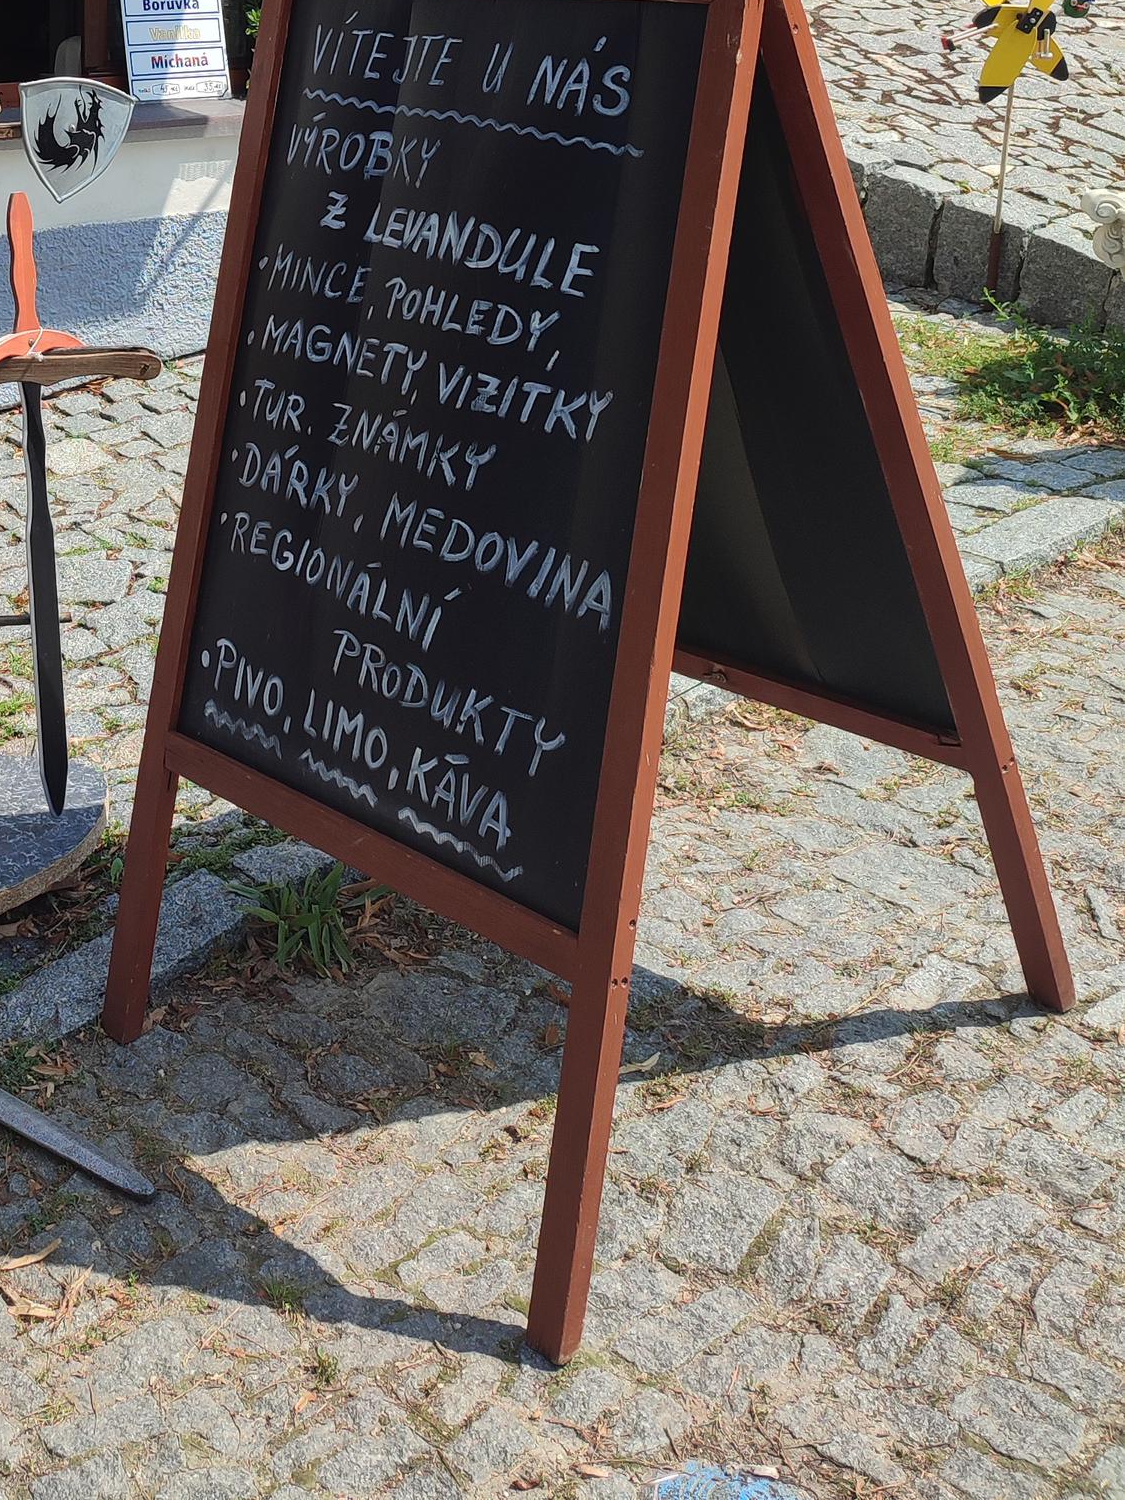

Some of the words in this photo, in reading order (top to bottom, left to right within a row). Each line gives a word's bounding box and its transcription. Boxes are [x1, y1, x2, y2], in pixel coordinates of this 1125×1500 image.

[149, 25, 201, 41] Vanilka
[312, 11, 463, 86] VÍTEJTE
[482, 42, 514, 93] U
[527, 35, 631, 116] NÁS
[286, 112, 442, 188] VÝROBKY
[363, 202, 600, 298] LEVANDULE
[252, 379, 313, 435] TUR.
[326, 403, 497, 491] ZNÁMKY
[438, 362, 614, 443] VIZITKY
[230, 511, 463, 652] REGIONÁLNÍ
[380, 492, 613, 633] MEDOVINA
[332, 629, 566, 777] PRODUKTY
[406, 747, 512, 851] KÁVA
